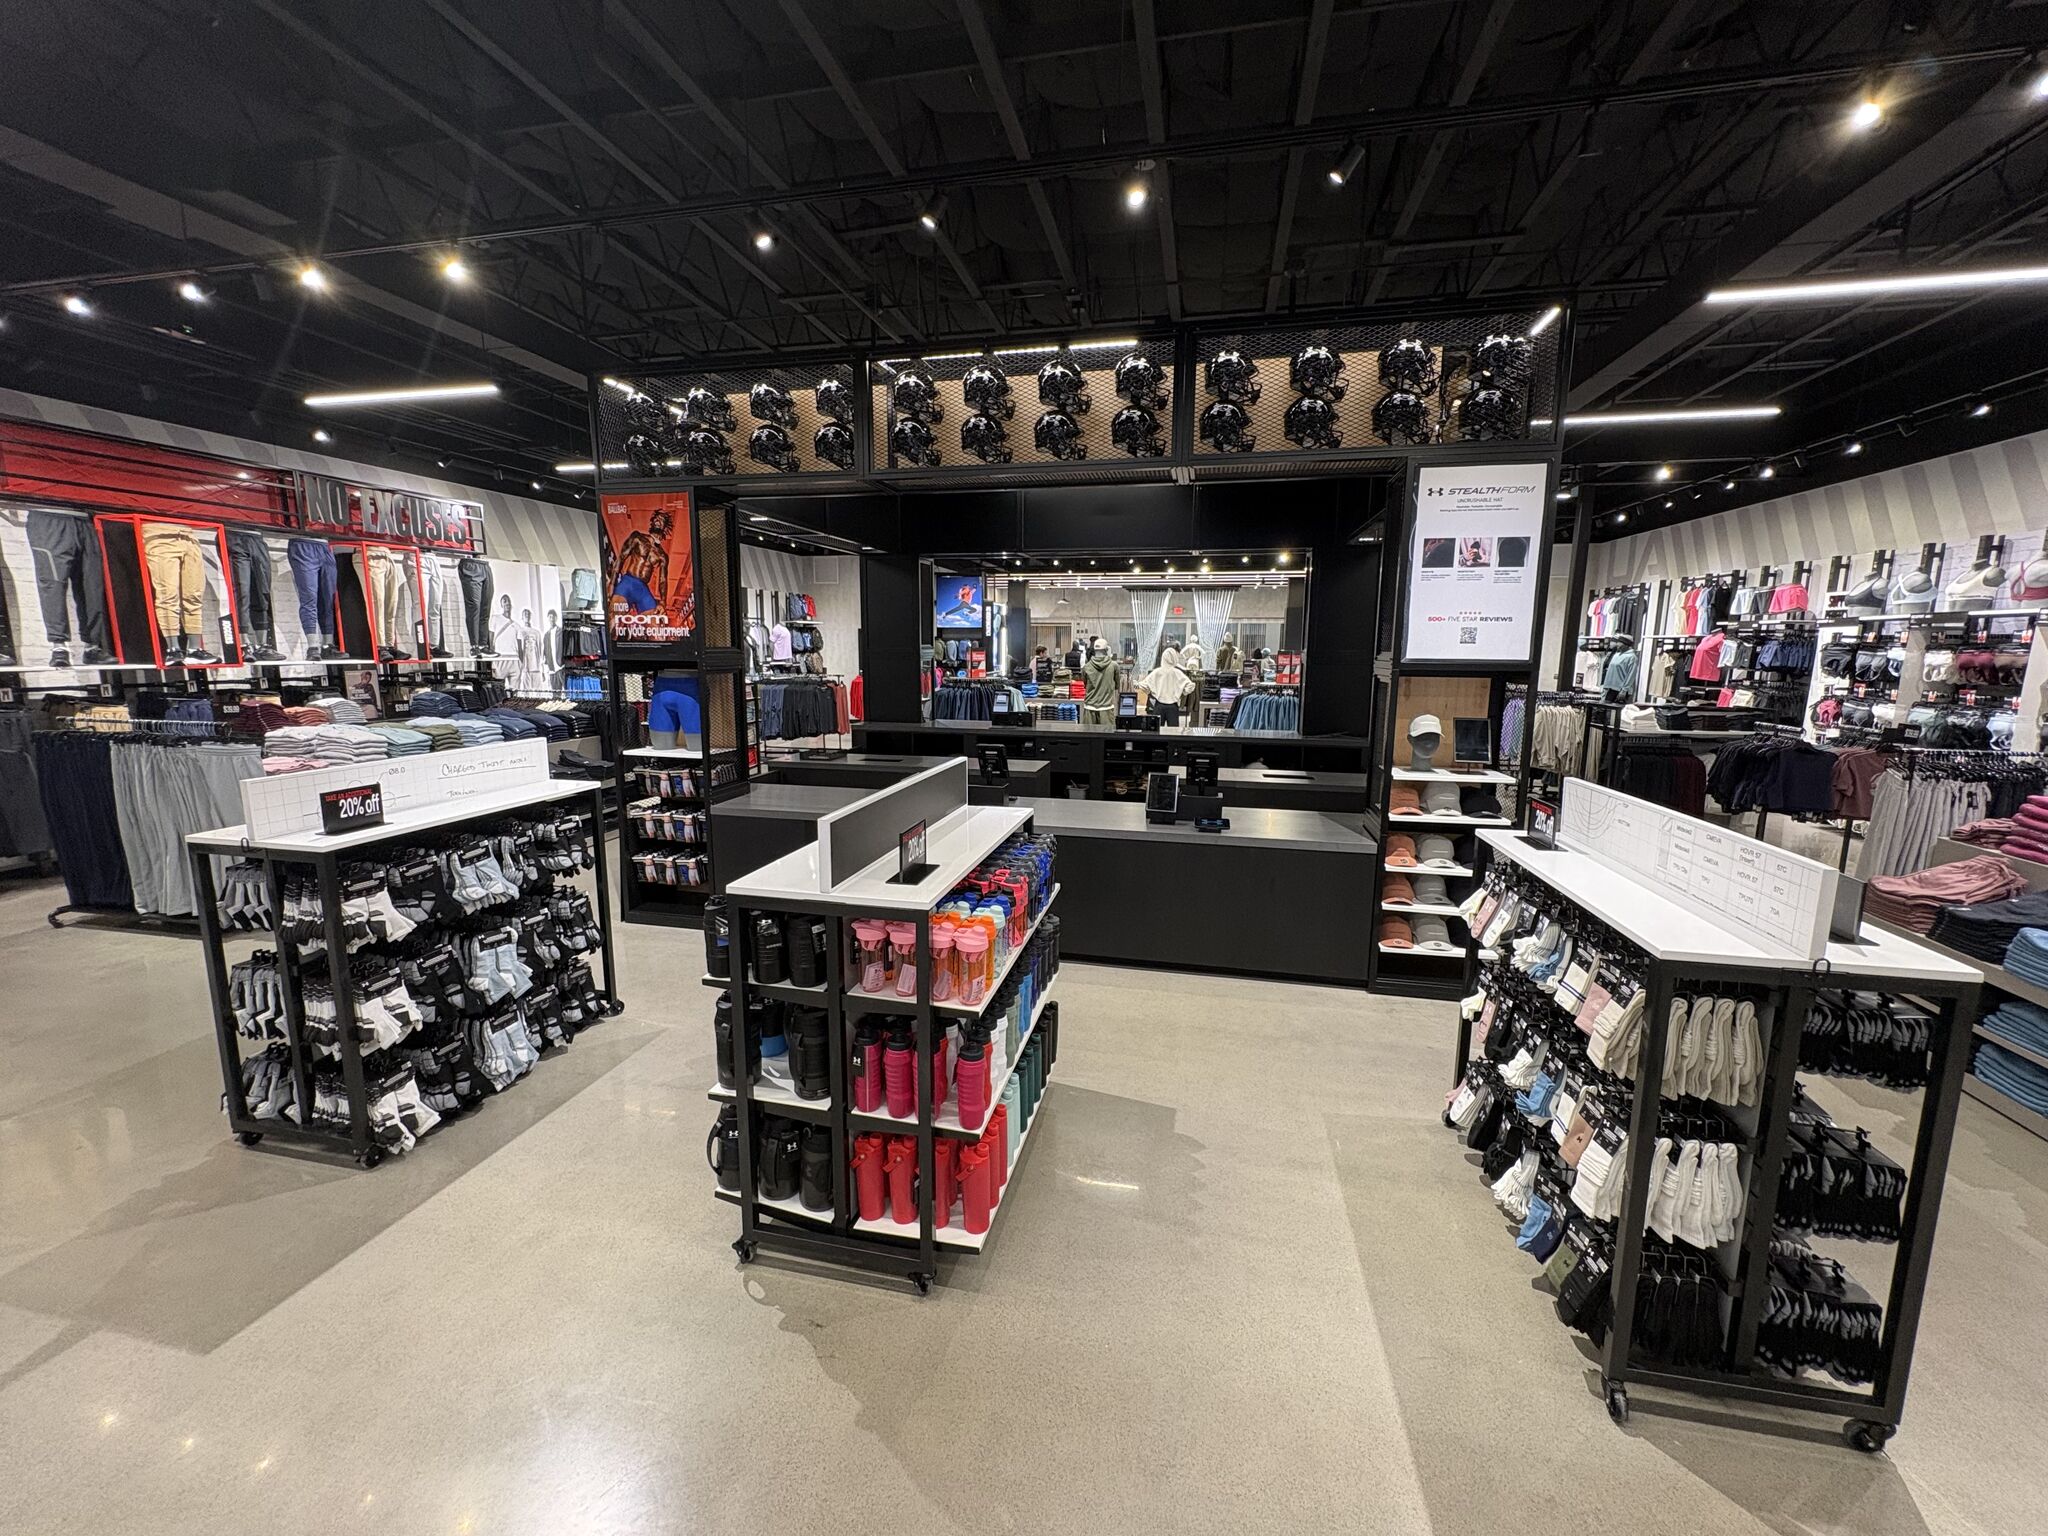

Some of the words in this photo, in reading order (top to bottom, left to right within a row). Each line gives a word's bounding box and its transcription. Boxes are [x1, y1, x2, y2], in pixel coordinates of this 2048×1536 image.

[1448, 486, 1536, 495] STEALTHFORM
[305, 475, 350, 526] NO
[360, 488, 467, 544] EXCUSES
[614, 602, 629, 612] more
[615, 614, 669, 624] room
[615, 624, 626, 636] for
[646, 625, 690, 641] equipment
[339, 796, 364, 818] 20%
[365, 793, 380, 813] off
